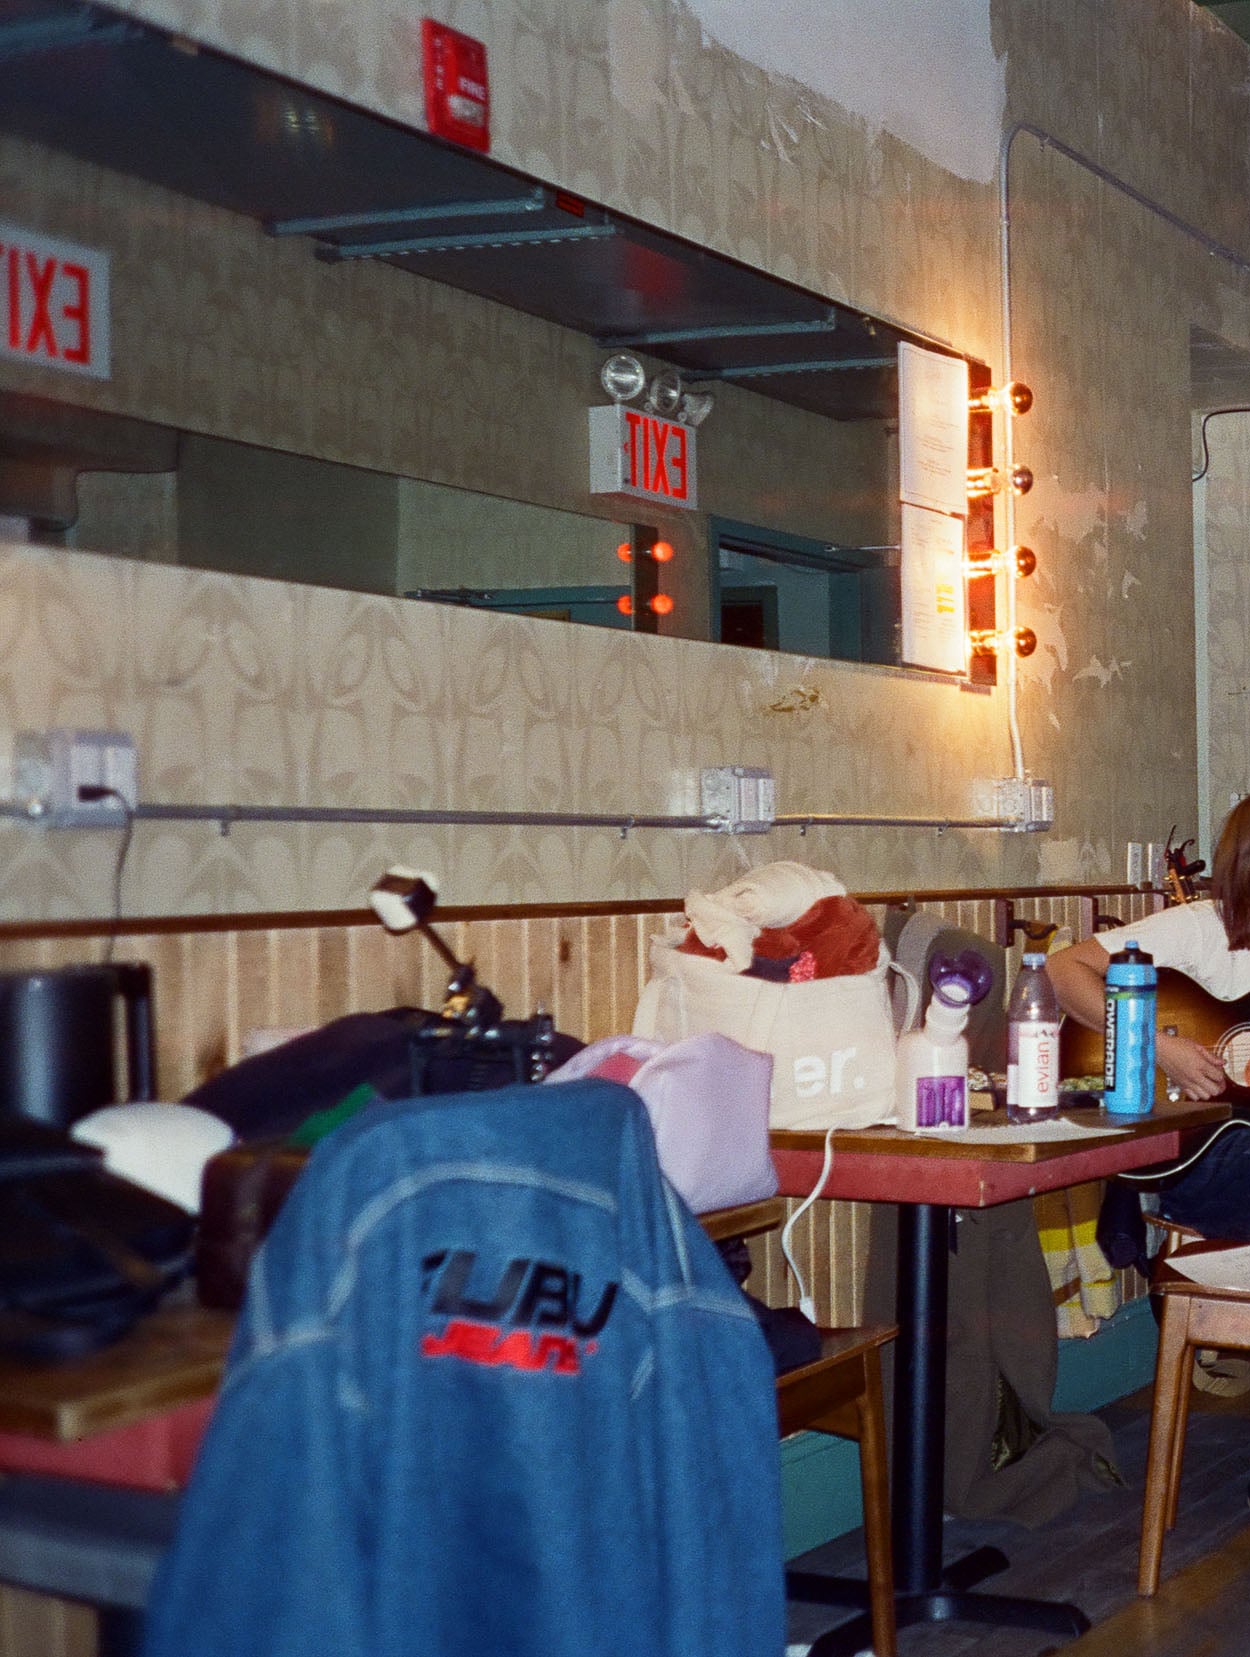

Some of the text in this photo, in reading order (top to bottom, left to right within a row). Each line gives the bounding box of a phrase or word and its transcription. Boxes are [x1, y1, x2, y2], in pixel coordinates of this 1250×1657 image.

[1037, 1041, 1049, 1093] evian
[1105, 998, 1116, 1087] OWERADE
[794, 1047, 865, 1098] er.
